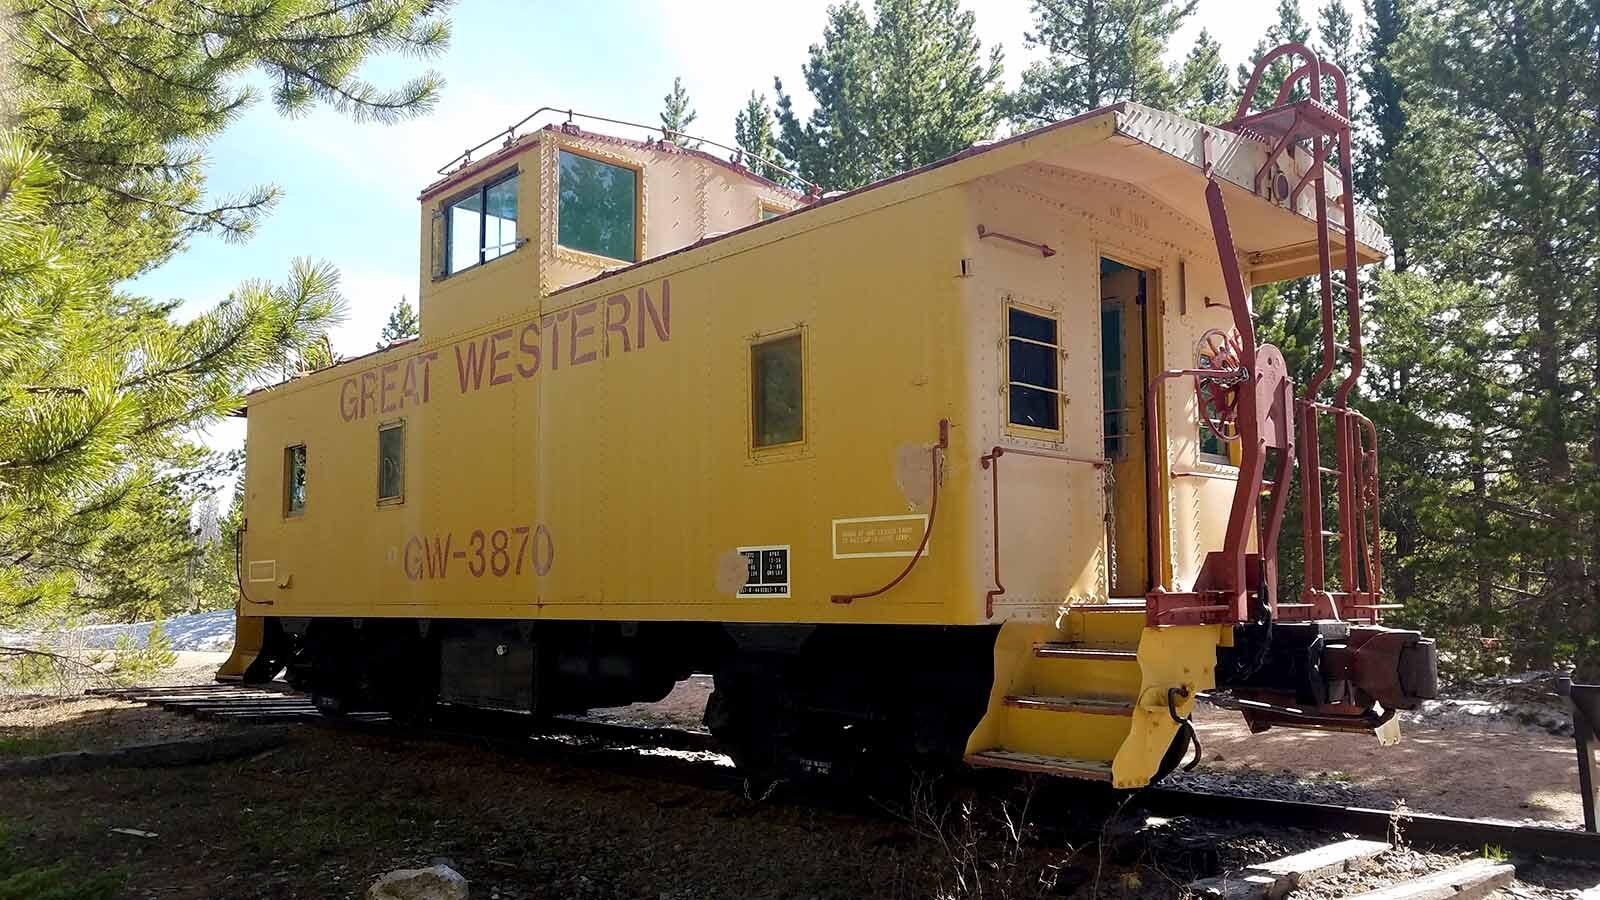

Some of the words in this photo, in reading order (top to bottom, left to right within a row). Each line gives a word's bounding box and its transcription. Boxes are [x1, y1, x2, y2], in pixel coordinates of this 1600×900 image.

[339, 351, 438, 422] GREAT
[454, 279, 671, 394] WESTERN
[404, 524, 554, 581] GW-3870
